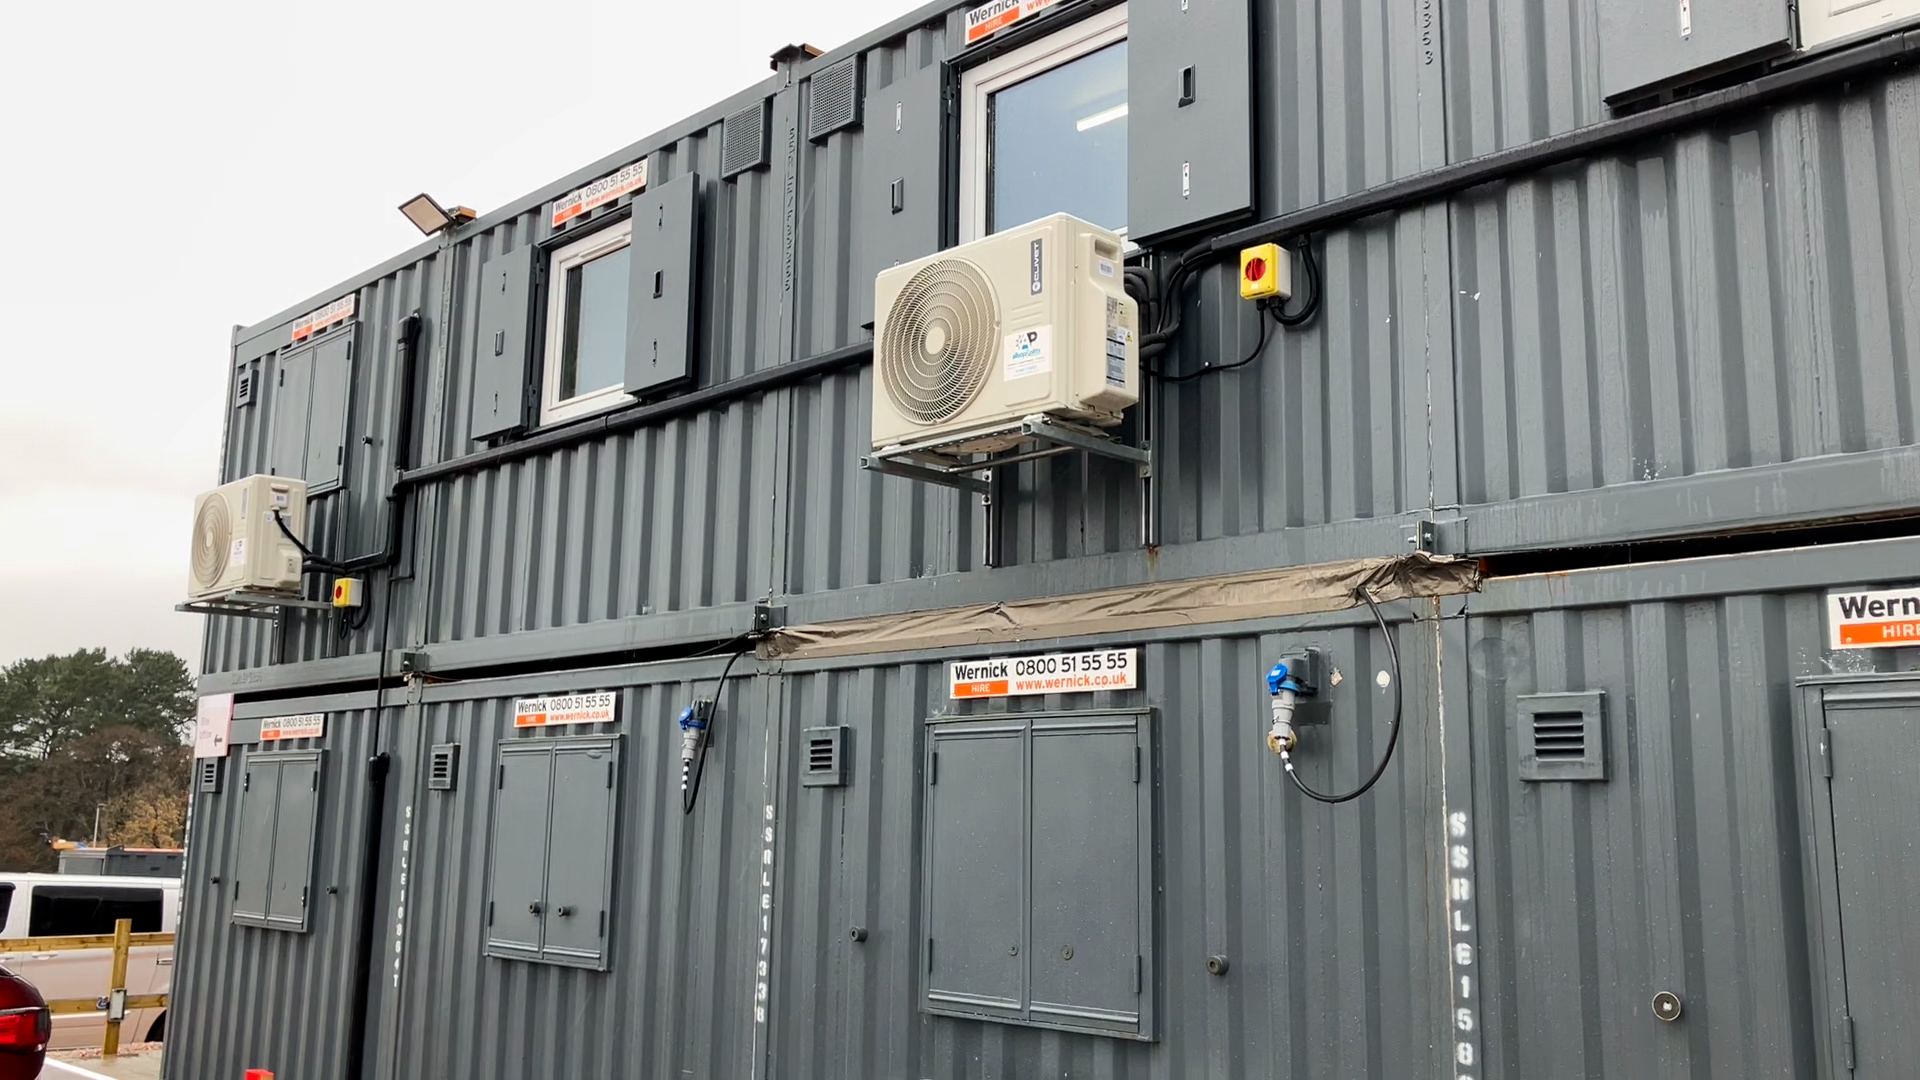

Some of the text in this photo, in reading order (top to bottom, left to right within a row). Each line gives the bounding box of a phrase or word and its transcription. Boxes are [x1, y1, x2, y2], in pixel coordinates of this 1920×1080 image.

[985, 18, 1003, 31] HIRE
[555, 163, 643, 212] Wernick 0800 51 55 55
[1838, 595, 1920, 619] Wern
[954, 652, 1127, 680] Wernick 0800 51 55 55
[971, 672, 1127, 693] HIRE www.wernick.co.uk
[518, 694, 610, 713] Wernick 0800 51 55 55
[282, 717, 297, 728] 0800
[298, 717, 304, 726] 51
[304, 716, 312, 726] 55
[313, 715, 321, 725] 55
[550, 710, 609, 721] www.wernick.co.uk
[1450, 811, 1474, 1080] SSRLE158
